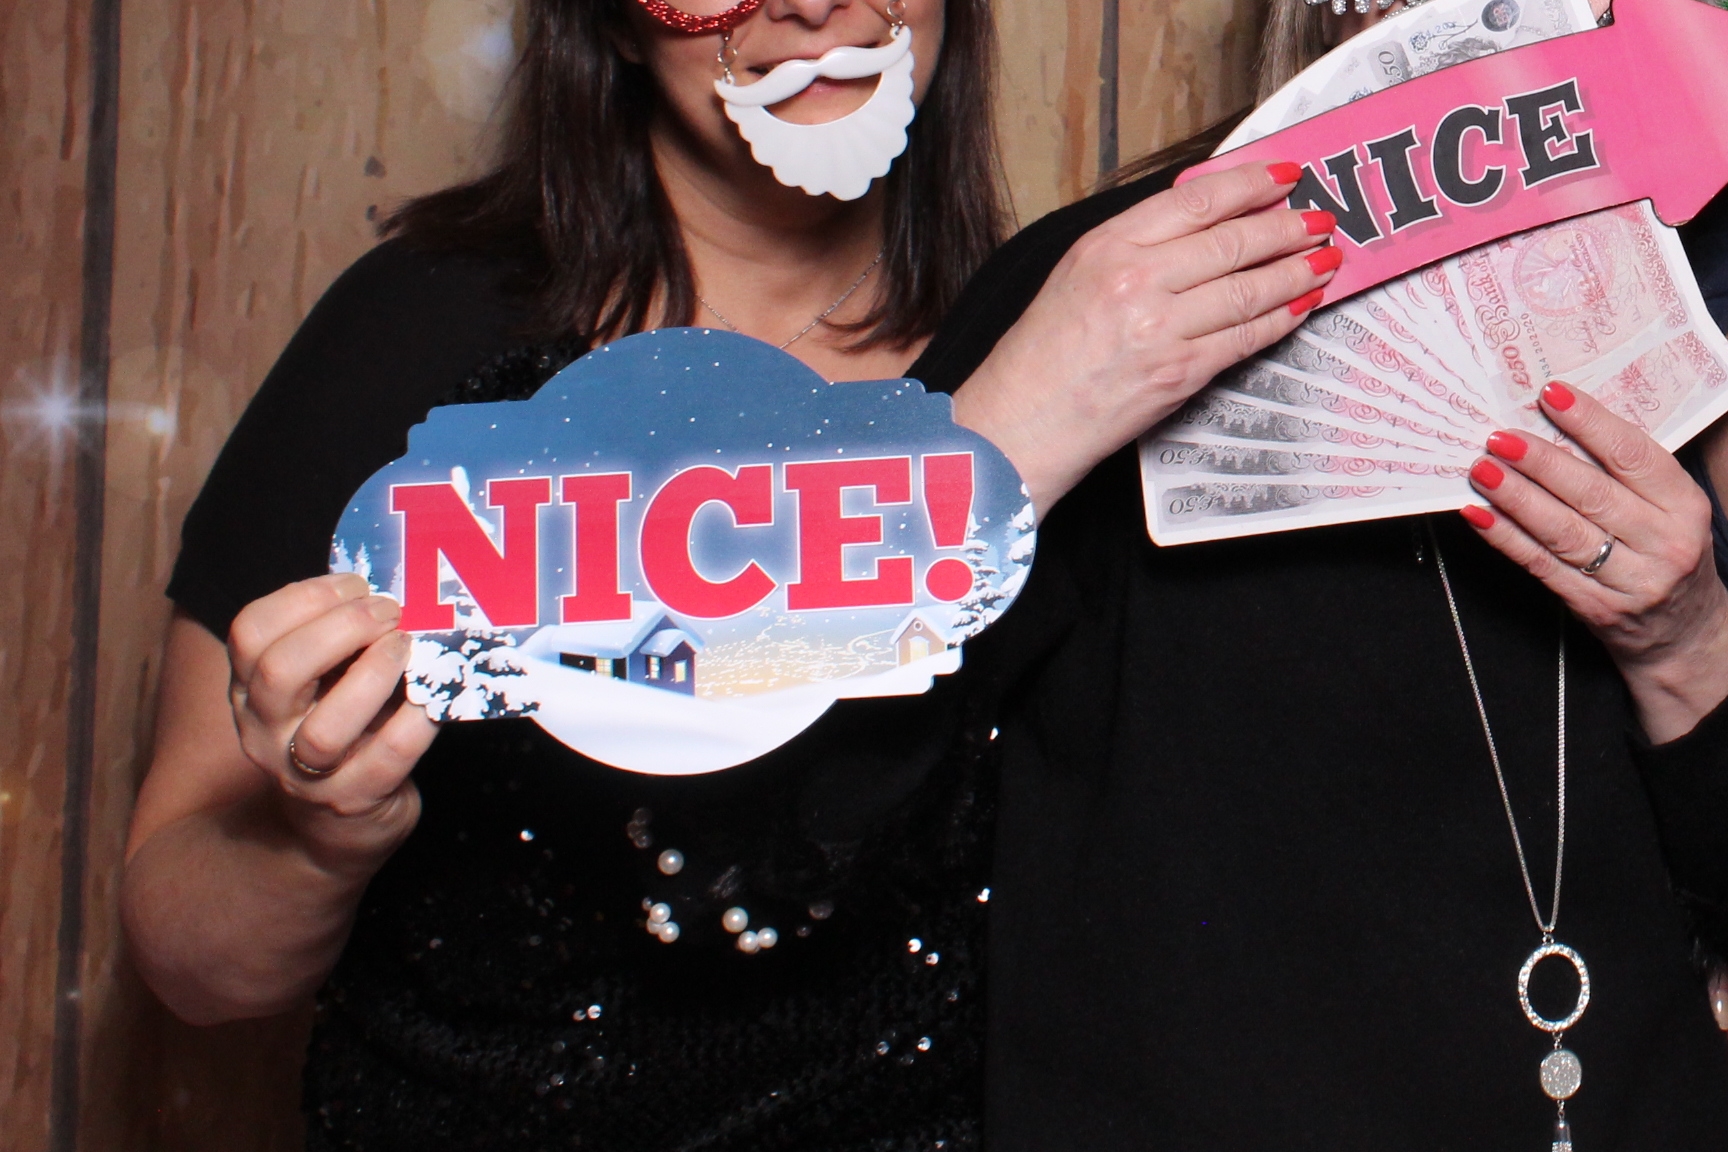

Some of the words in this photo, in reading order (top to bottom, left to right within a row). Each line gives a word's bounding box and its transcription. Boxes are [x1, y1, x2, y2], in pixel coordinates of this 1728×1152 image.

[1287, 77, 1600, 248] NICE
[1466, 274, 1521, 349] Bank
[1502, 346, 1532, 388] £50
[1159, 447, 1210, 466] £50
[1169, 495, 1219, 515] £50
[390, 452, 975, 633] NICE!
